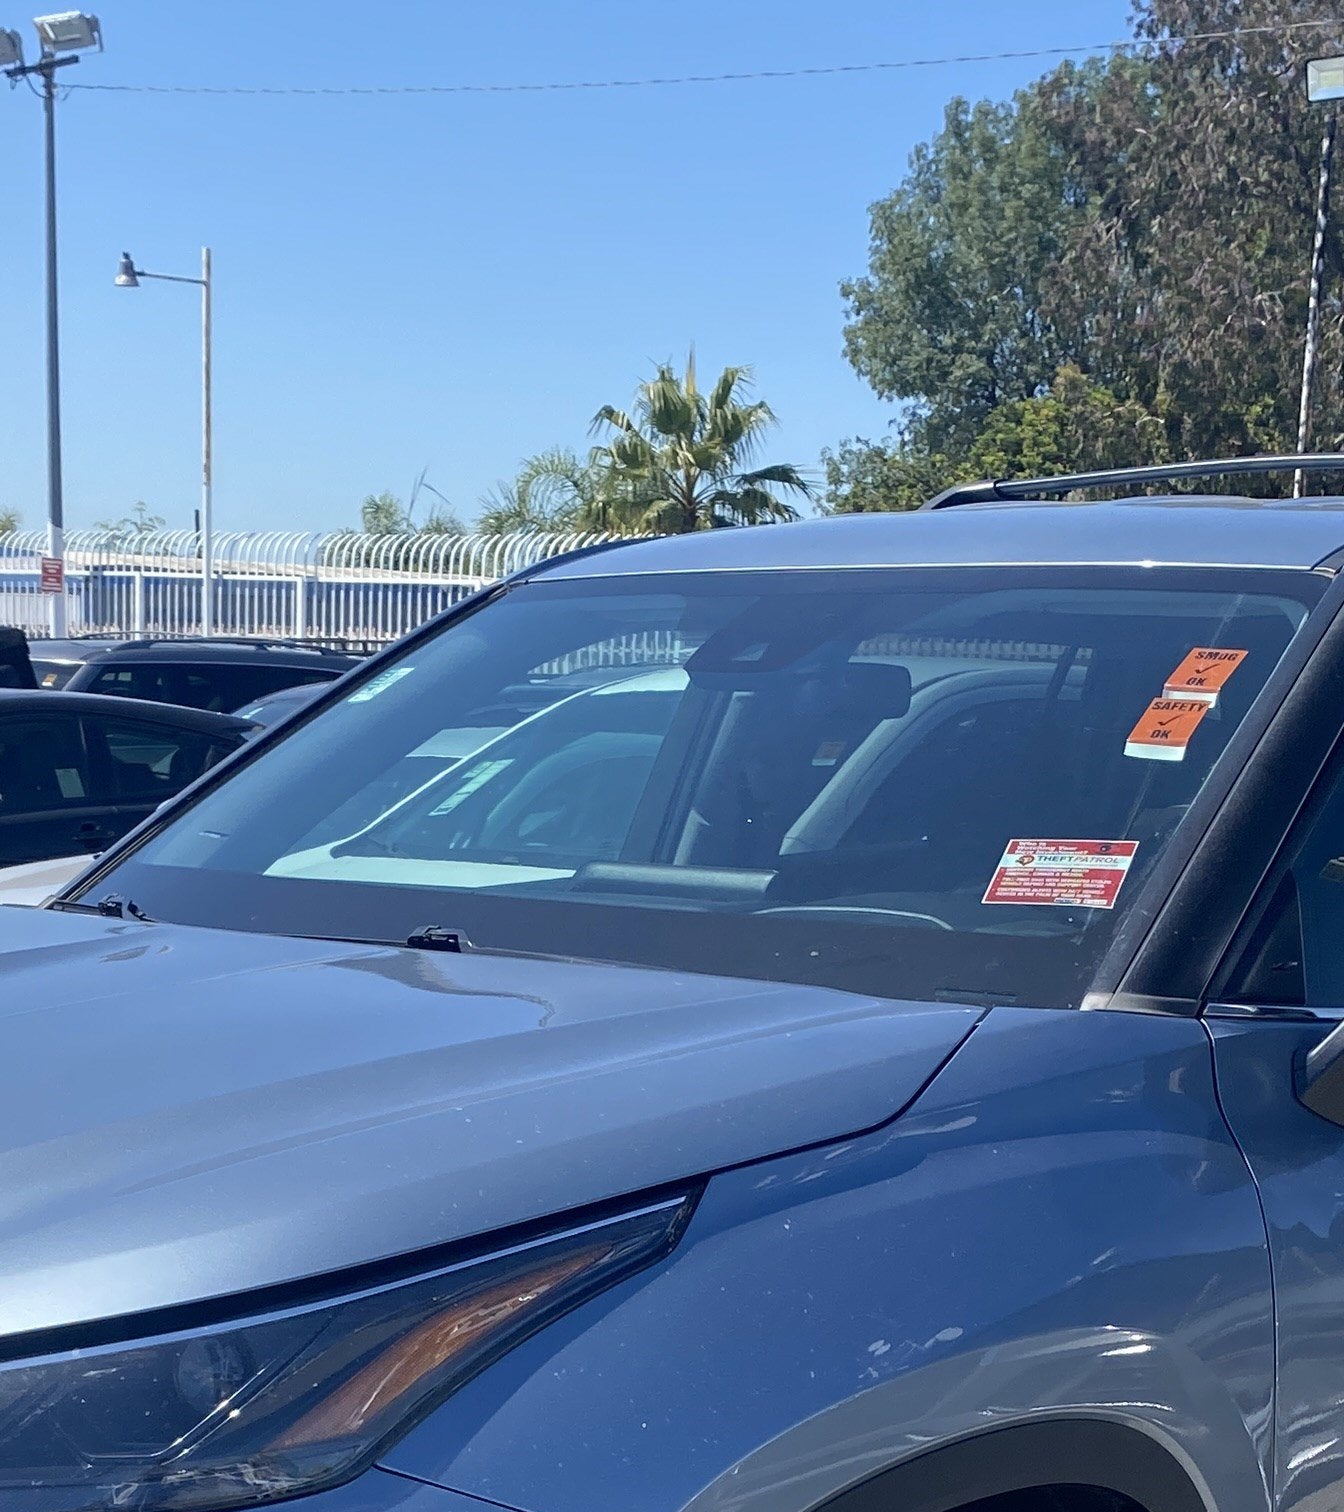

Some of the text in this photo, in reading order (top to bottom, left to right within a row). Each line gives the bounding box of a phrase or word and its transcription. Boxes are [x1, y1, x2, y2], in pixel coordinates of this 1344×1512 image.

[1195, 651, 1239, 661] SMOG
[1186, 677, 1207, 686] OK
[1152, 701, 1206, 712] SAFETY
[1150, 729, 1172, 739] OK
